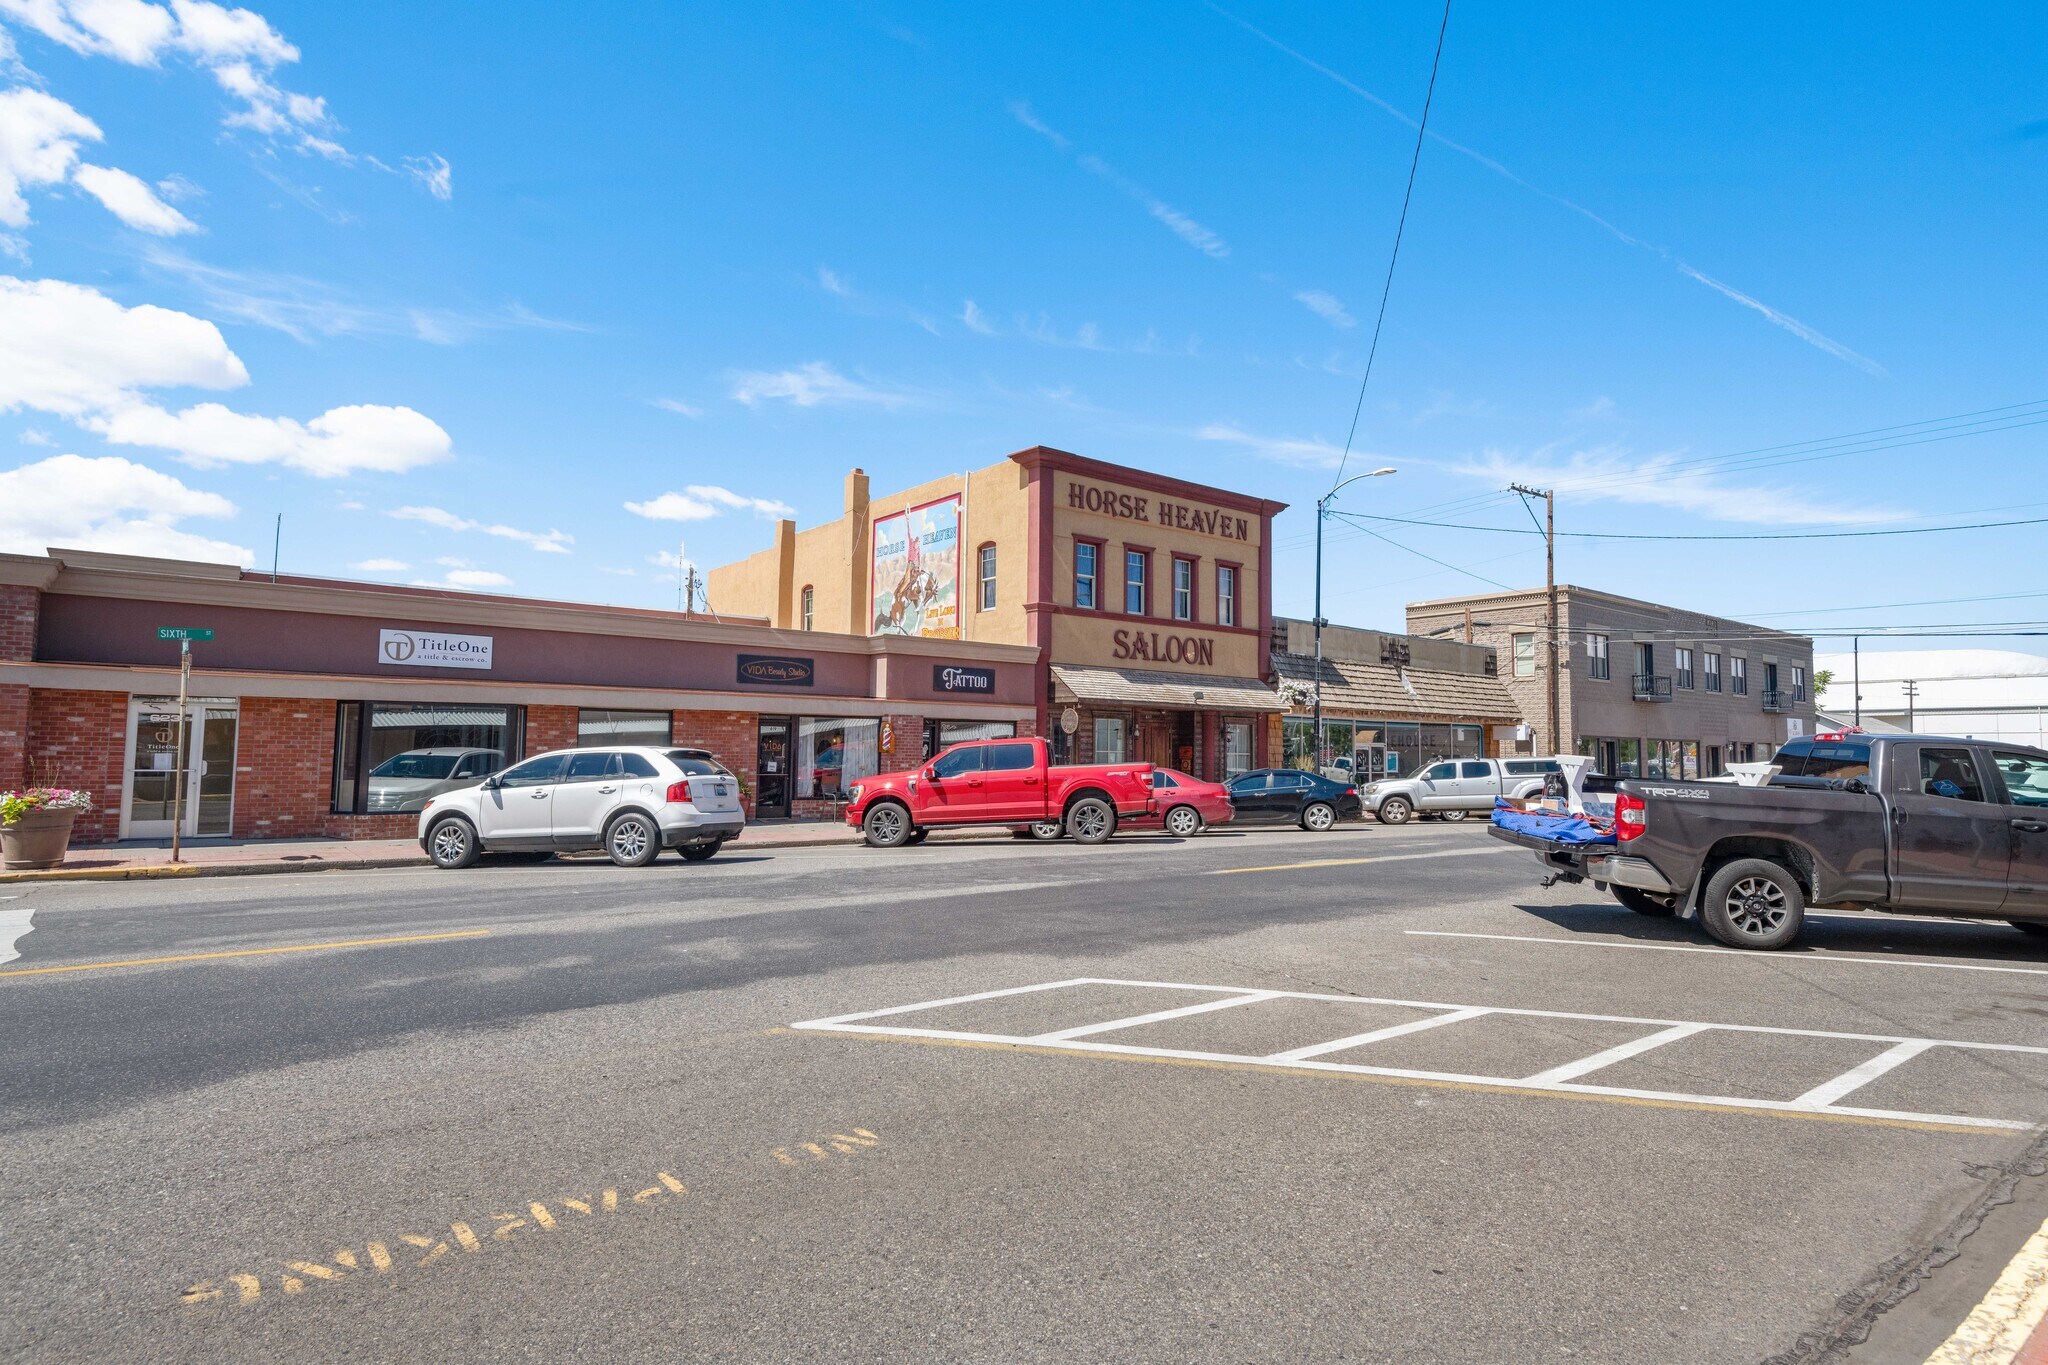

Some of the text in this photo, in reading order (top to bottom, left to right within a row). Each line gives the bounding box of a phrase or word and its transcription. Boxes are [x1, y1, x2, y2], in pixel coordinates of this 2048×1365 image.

[1068, 482, 1248, 541] HORSE HEAVEN
[876, 526, 957, 557] HORSE HEAVEN
[160, 629, 187, 638] SIXTH
[418, 638, 488, 654] TitleOne
[1112, 629, 1214, 666] SALOON
[747, 665, 767, 675] VIDA
[1640, 787, 1677, 797] TRD
